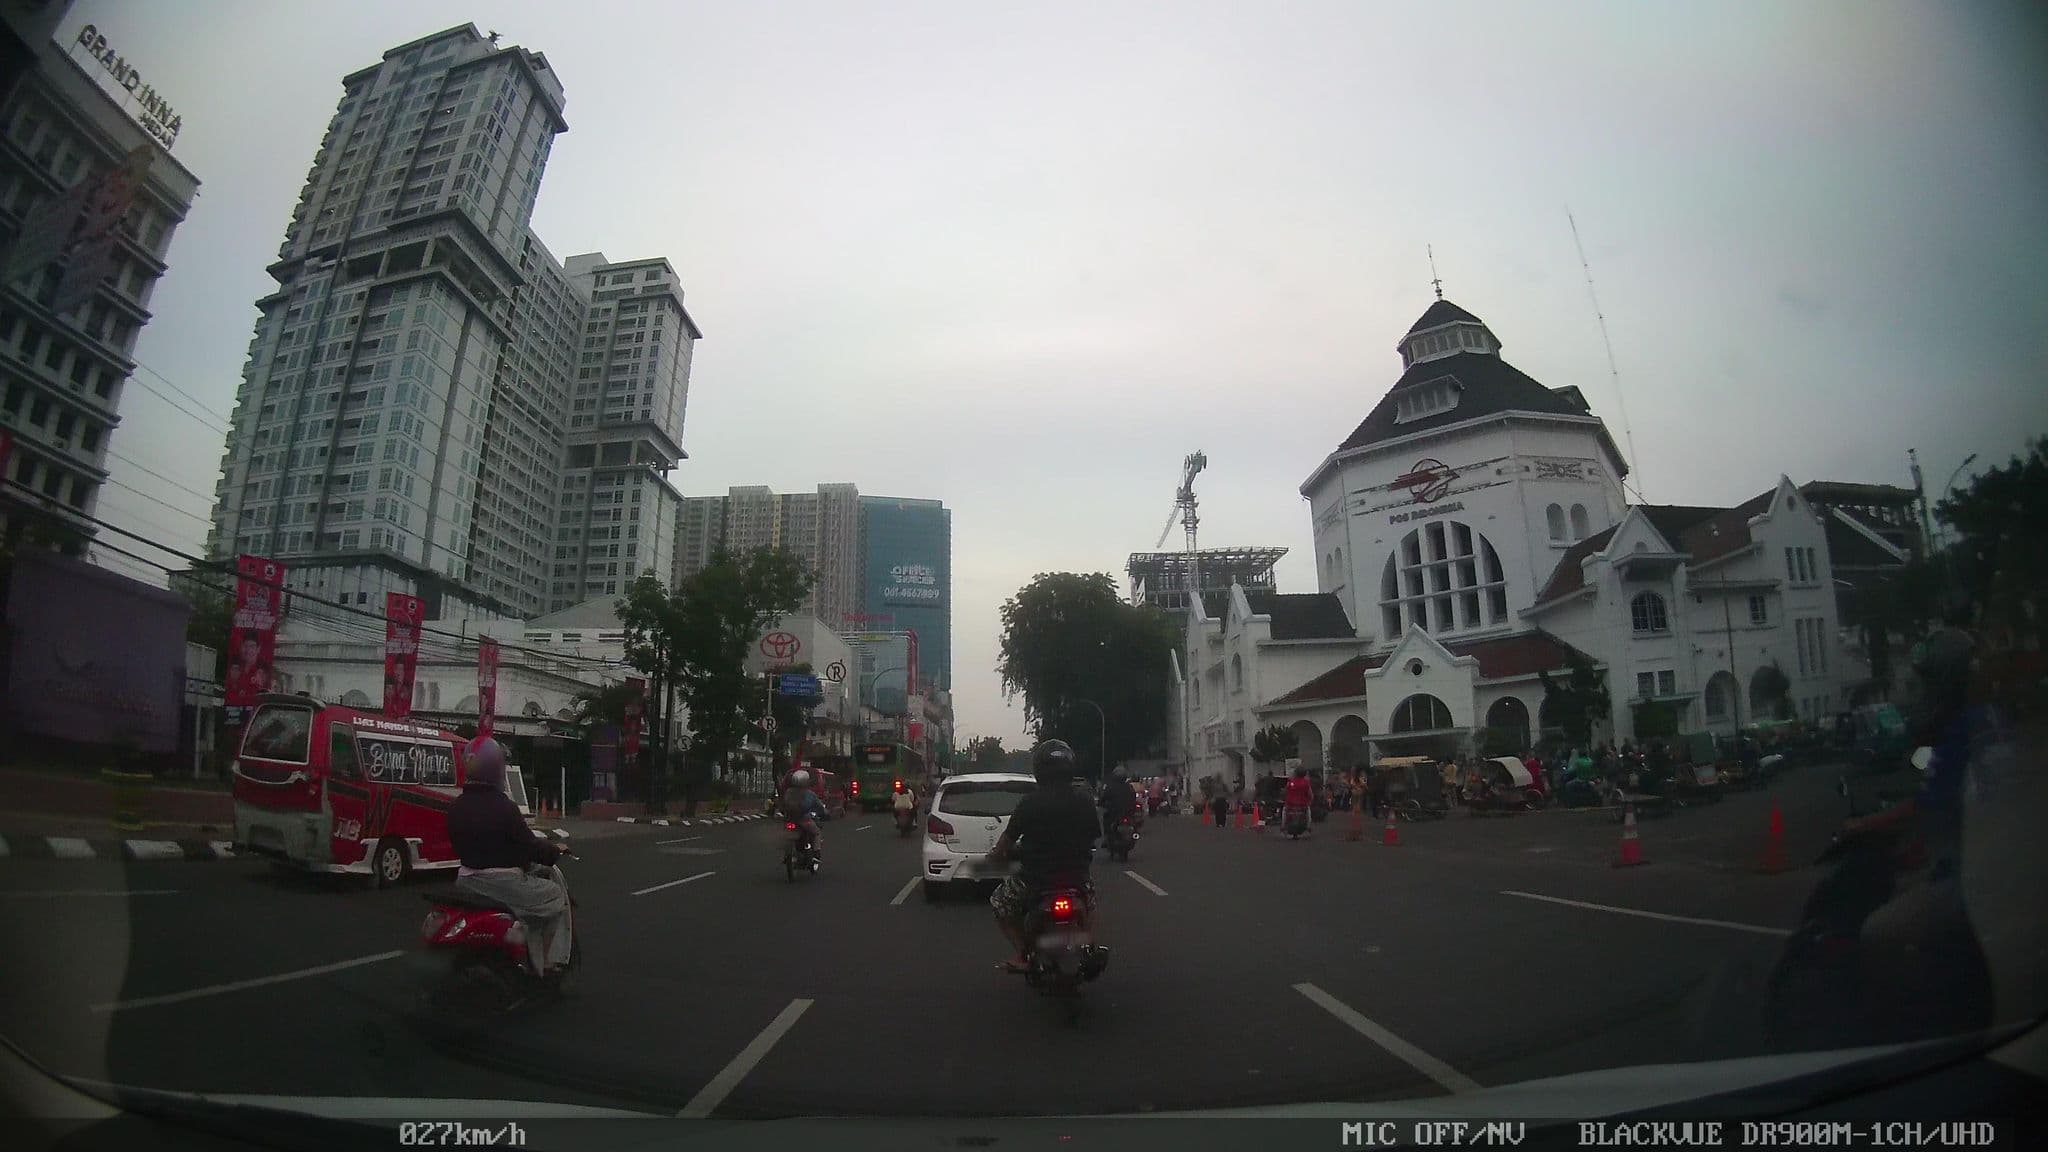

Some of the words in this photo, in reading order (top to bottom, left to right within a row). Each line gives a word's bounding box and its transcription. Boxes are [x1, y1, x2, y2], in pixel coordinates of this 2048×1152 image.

[79, 24, 141, 92] GRAND
[136, 84, 183, 136] INNA
[1389, 513, 1409, 525] POS
